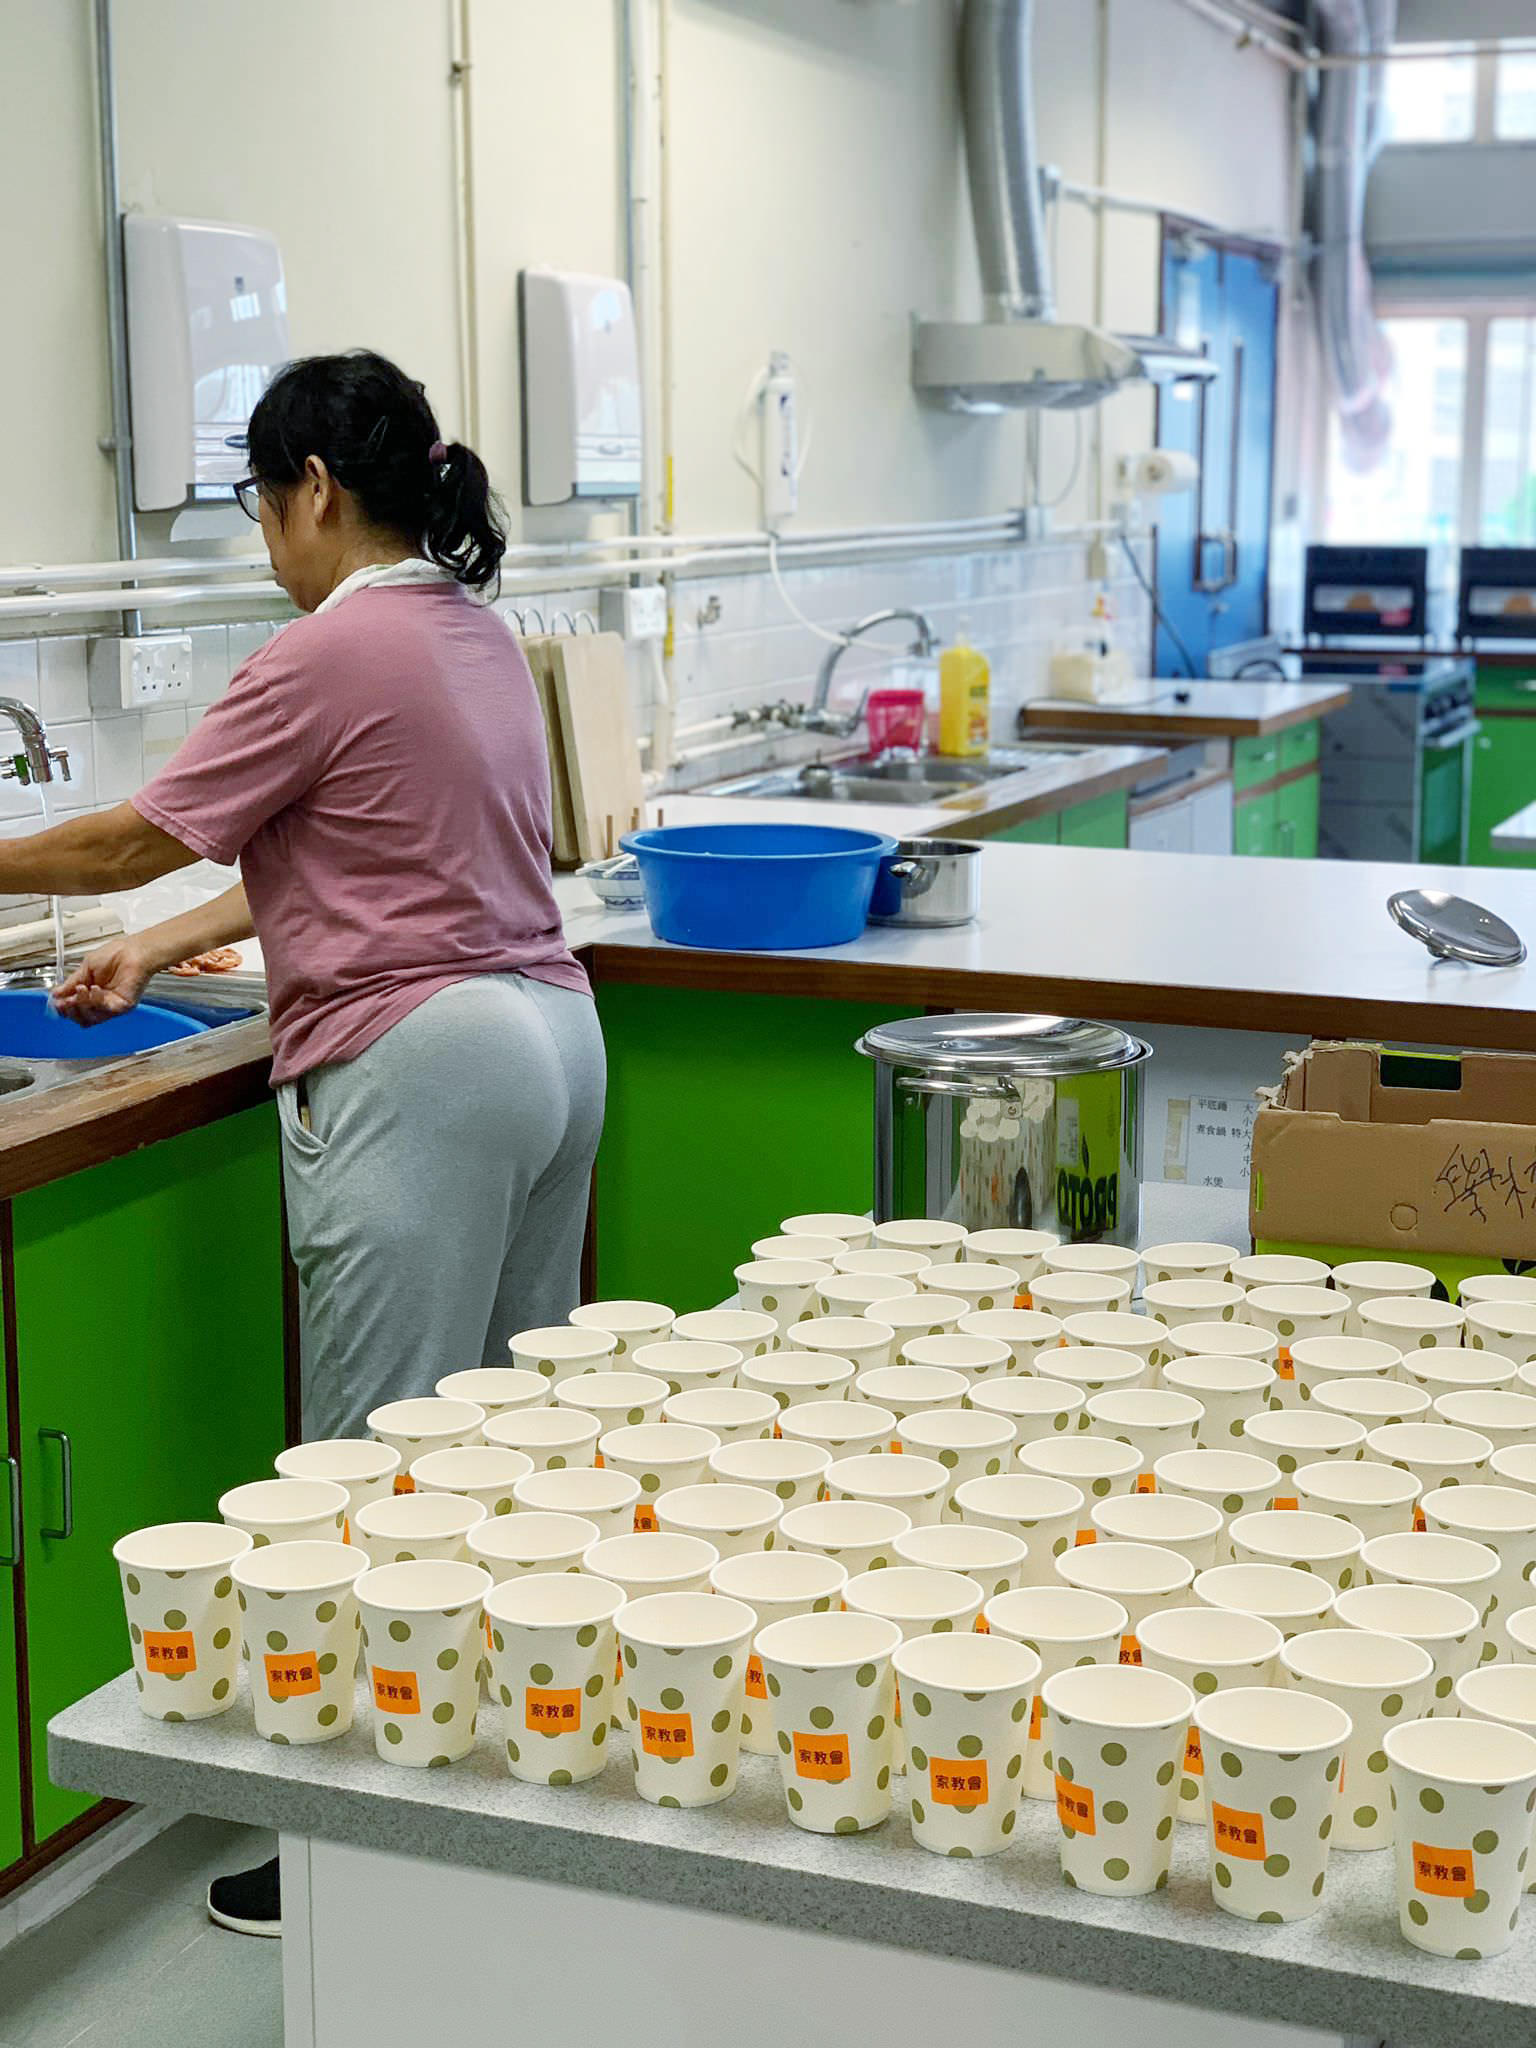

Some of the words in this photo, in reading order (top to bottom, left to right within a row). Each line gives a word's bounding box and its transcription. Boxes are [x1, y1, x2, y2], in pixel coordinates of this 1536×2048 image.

[148, 1645, 189, 1661] 家教會
[269, 1666, 313, 1684] 家教會
[375, 1682, 413, 1700] 家教會
[530, 1703, 575, 1719] 家教會
[644, 1725, 687, 1743] 家教會
[798, 1748, 844, 1766] 家教會
[935, 1774, 982, 1791] 家教會
[1056, 1793, 1089, 1819] 家教會
[1215, 1820, 1258, 1845] 家教會
[1417, 1860, 1467, 1882] 家教會
